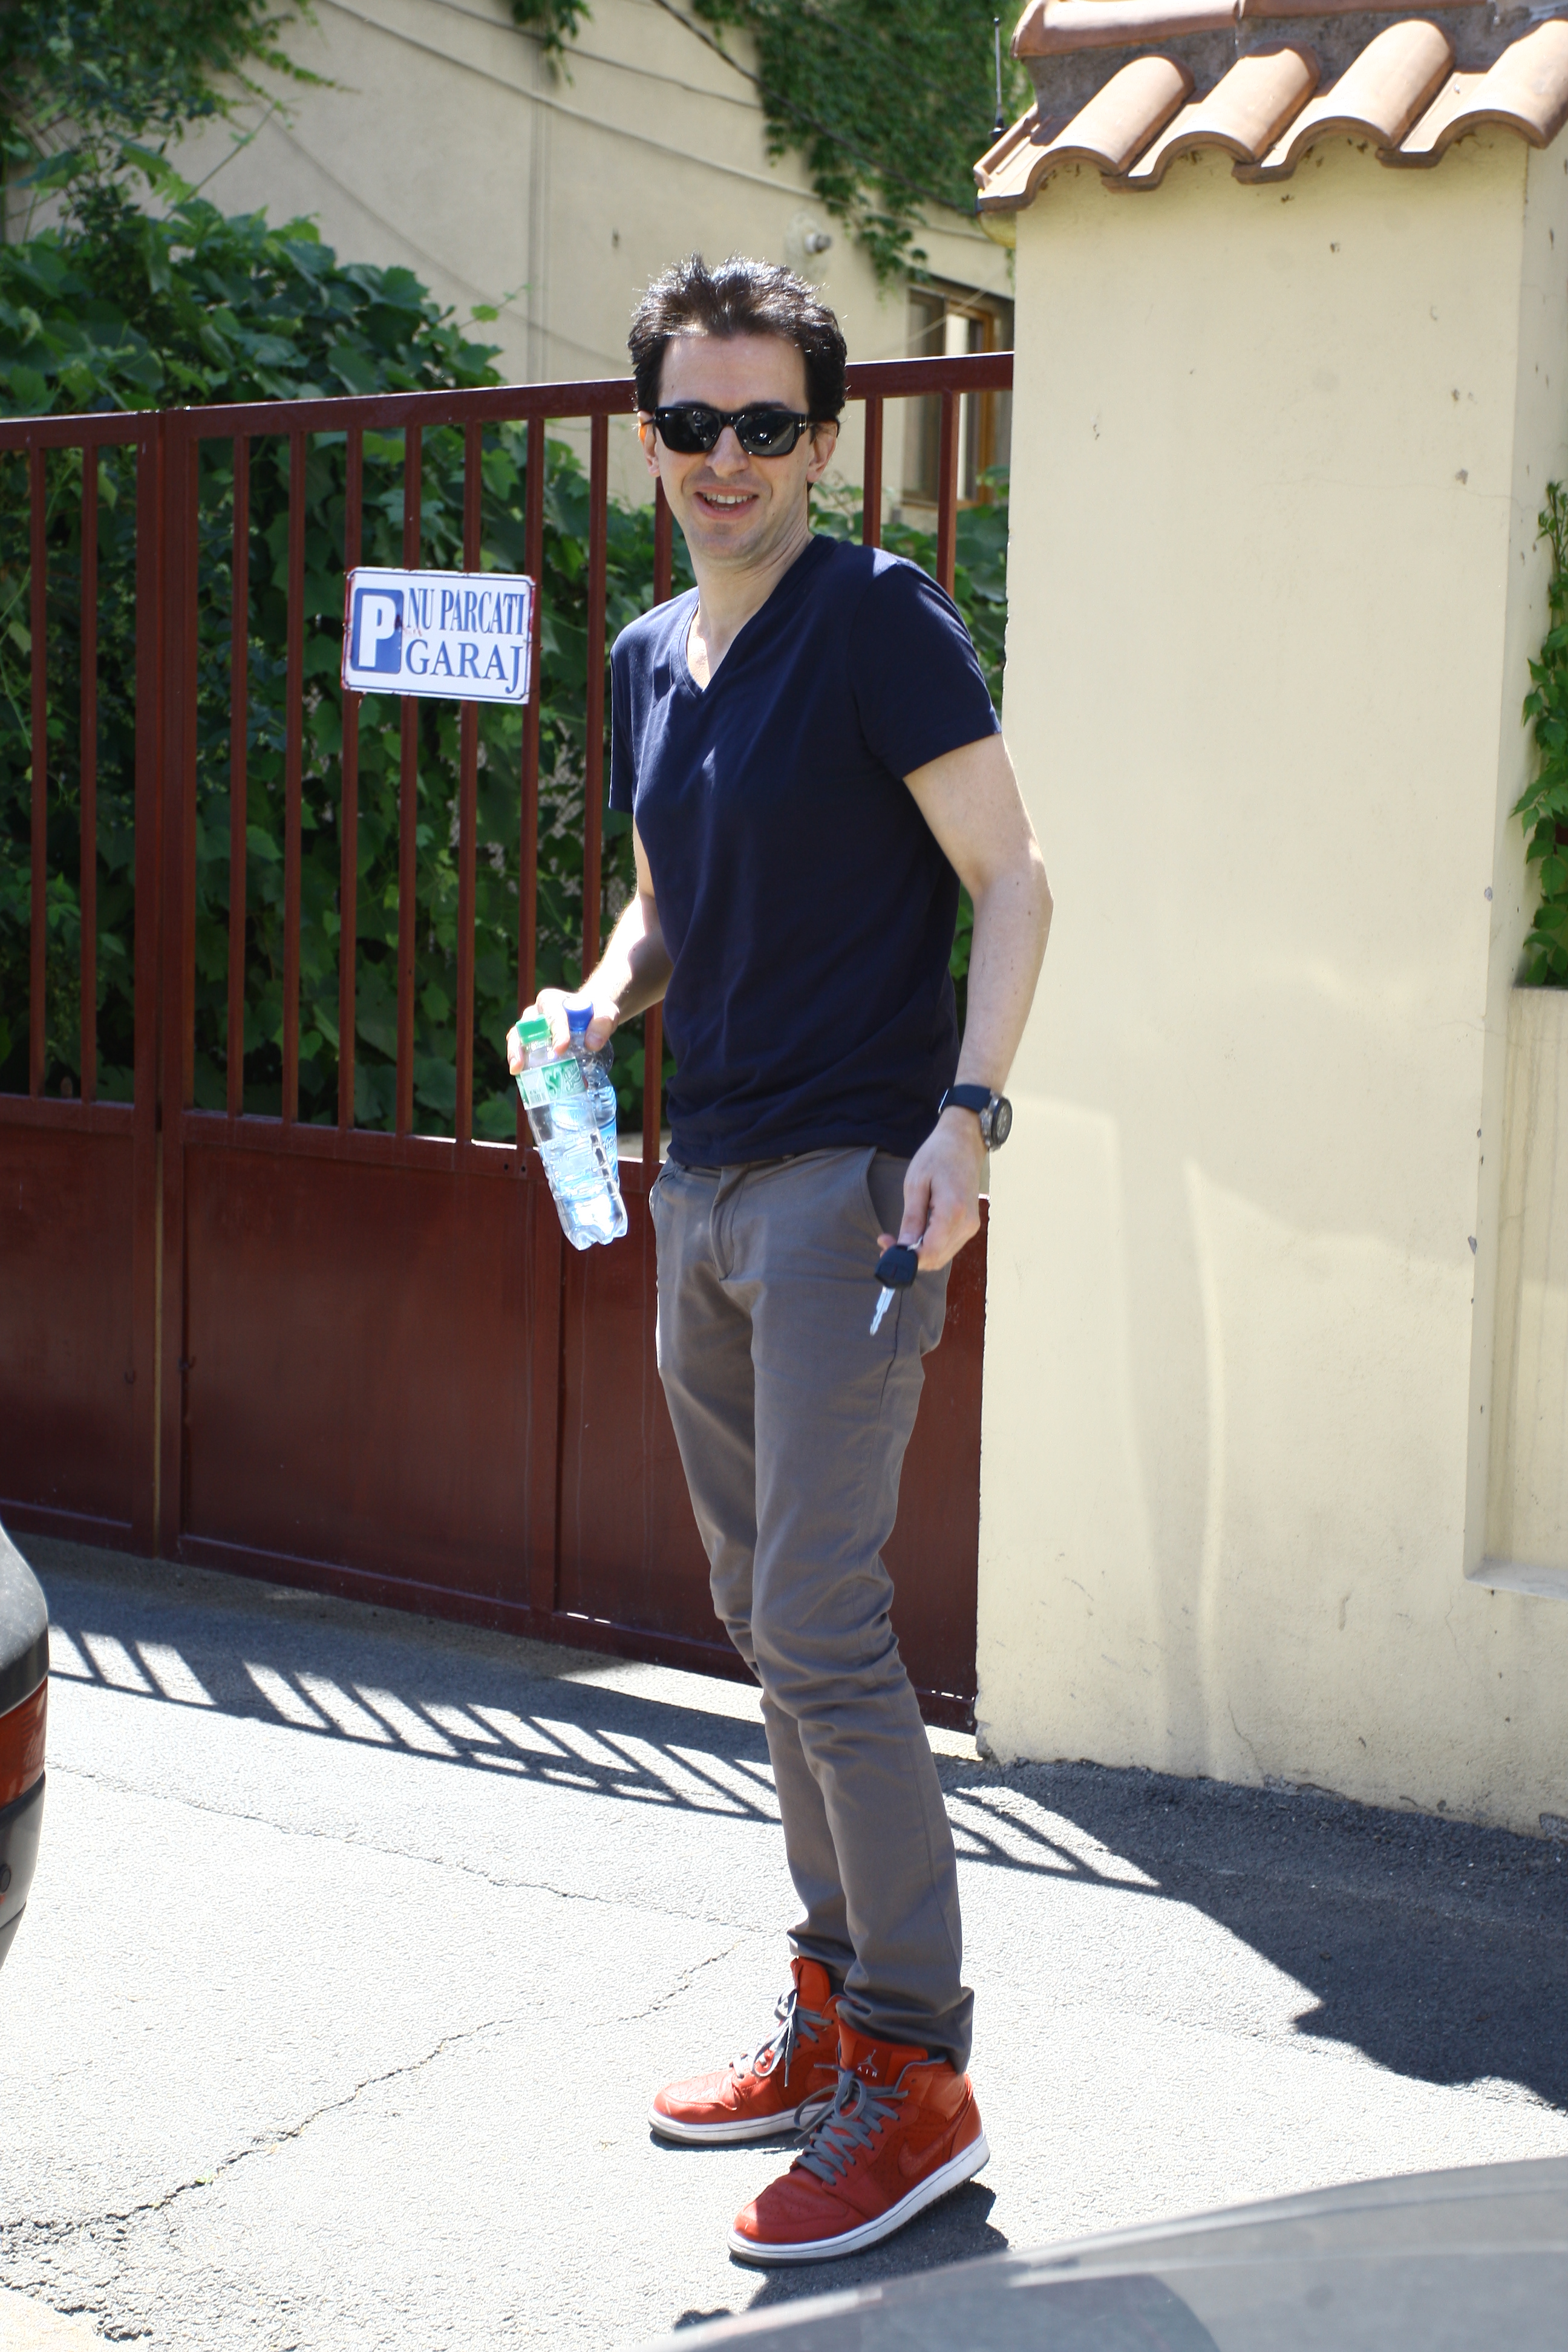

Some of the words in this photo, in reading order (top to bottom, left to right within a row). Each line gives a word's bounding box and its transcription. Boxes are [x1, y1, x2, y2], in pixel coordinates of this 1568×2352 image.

[359, 595, 397, 668] P
[407, 587, 434, 630] NU
[439, 589, 525, 635] PARCATI
[405, 639, 523, 694] GARAJ
[857, 2066, 877, 2077] AIR
